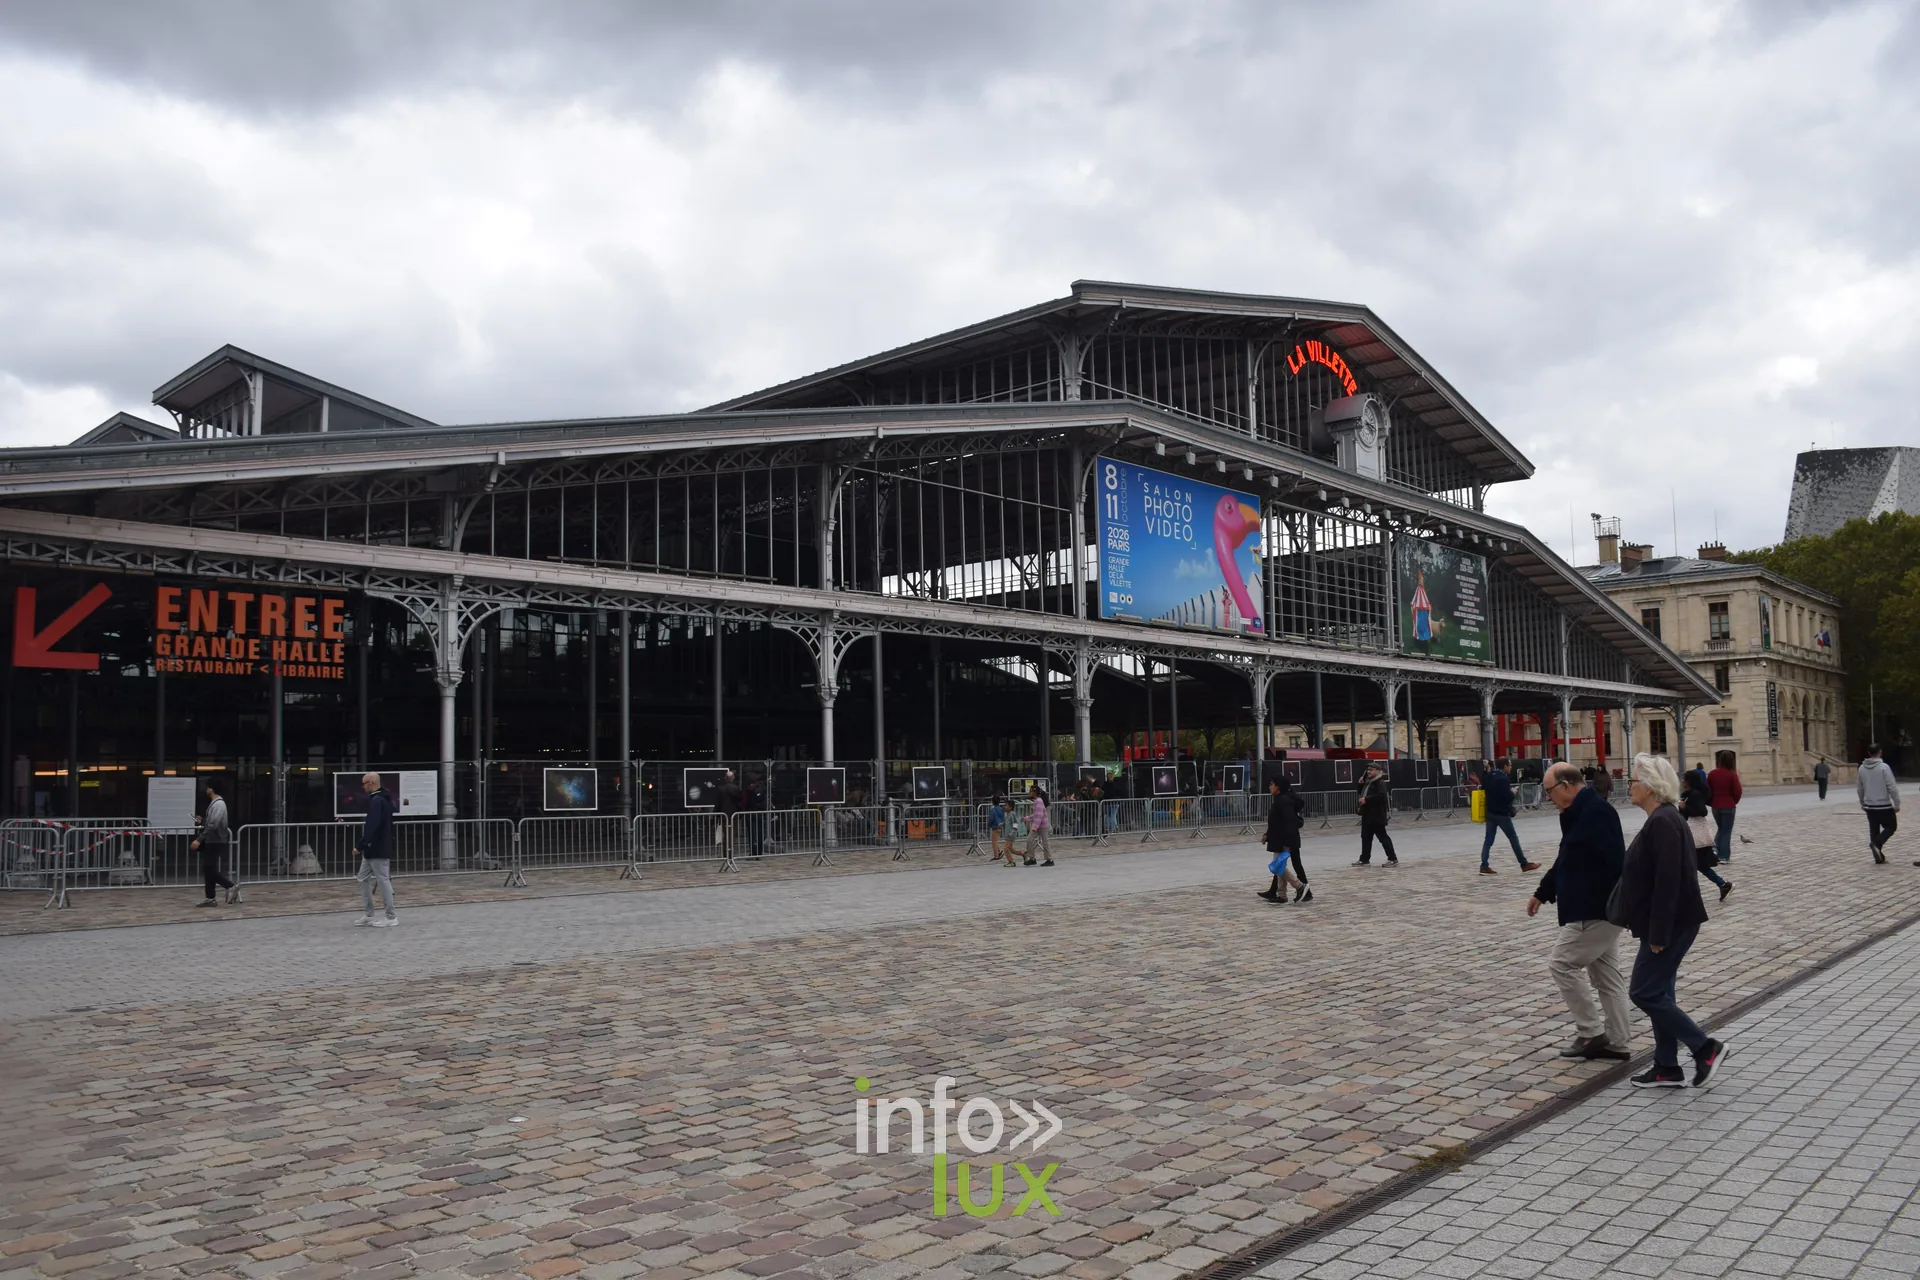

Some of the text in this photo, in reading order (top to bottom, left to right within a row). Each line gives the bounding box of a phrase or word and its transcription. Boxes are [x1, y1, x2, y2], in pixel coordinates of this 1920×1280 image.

[1287, 340, 1358, 397] LA VILLETTE
[1105, 464, 1118, 490] 8
[1120, 468, 1128, 522] octobre
[1143, 482, 1192, 503] SALON
[1106, 493, 1118, 520] 11
[1144, 495, 1192, 522] PHOTO
[1107, 526, 1130, 541] 2026
[1145, 515, 1193, 542] VIDEO
[1107, 538, 1130, 552] PARIS
[1108, 556, 1130, 567] GRANDE
[1108, 564, 1125, 573] HALLE
[1108, 571, 1124, 580] DE LA
[1108, 579, 1132, 589] VILLETTE
[156, 586, 344, 640] ENTREE
[156, 633, 345, 663] GRANDE HALLE
[155, 658, 344, 679] RESTAURANT LIBRAIRIE
